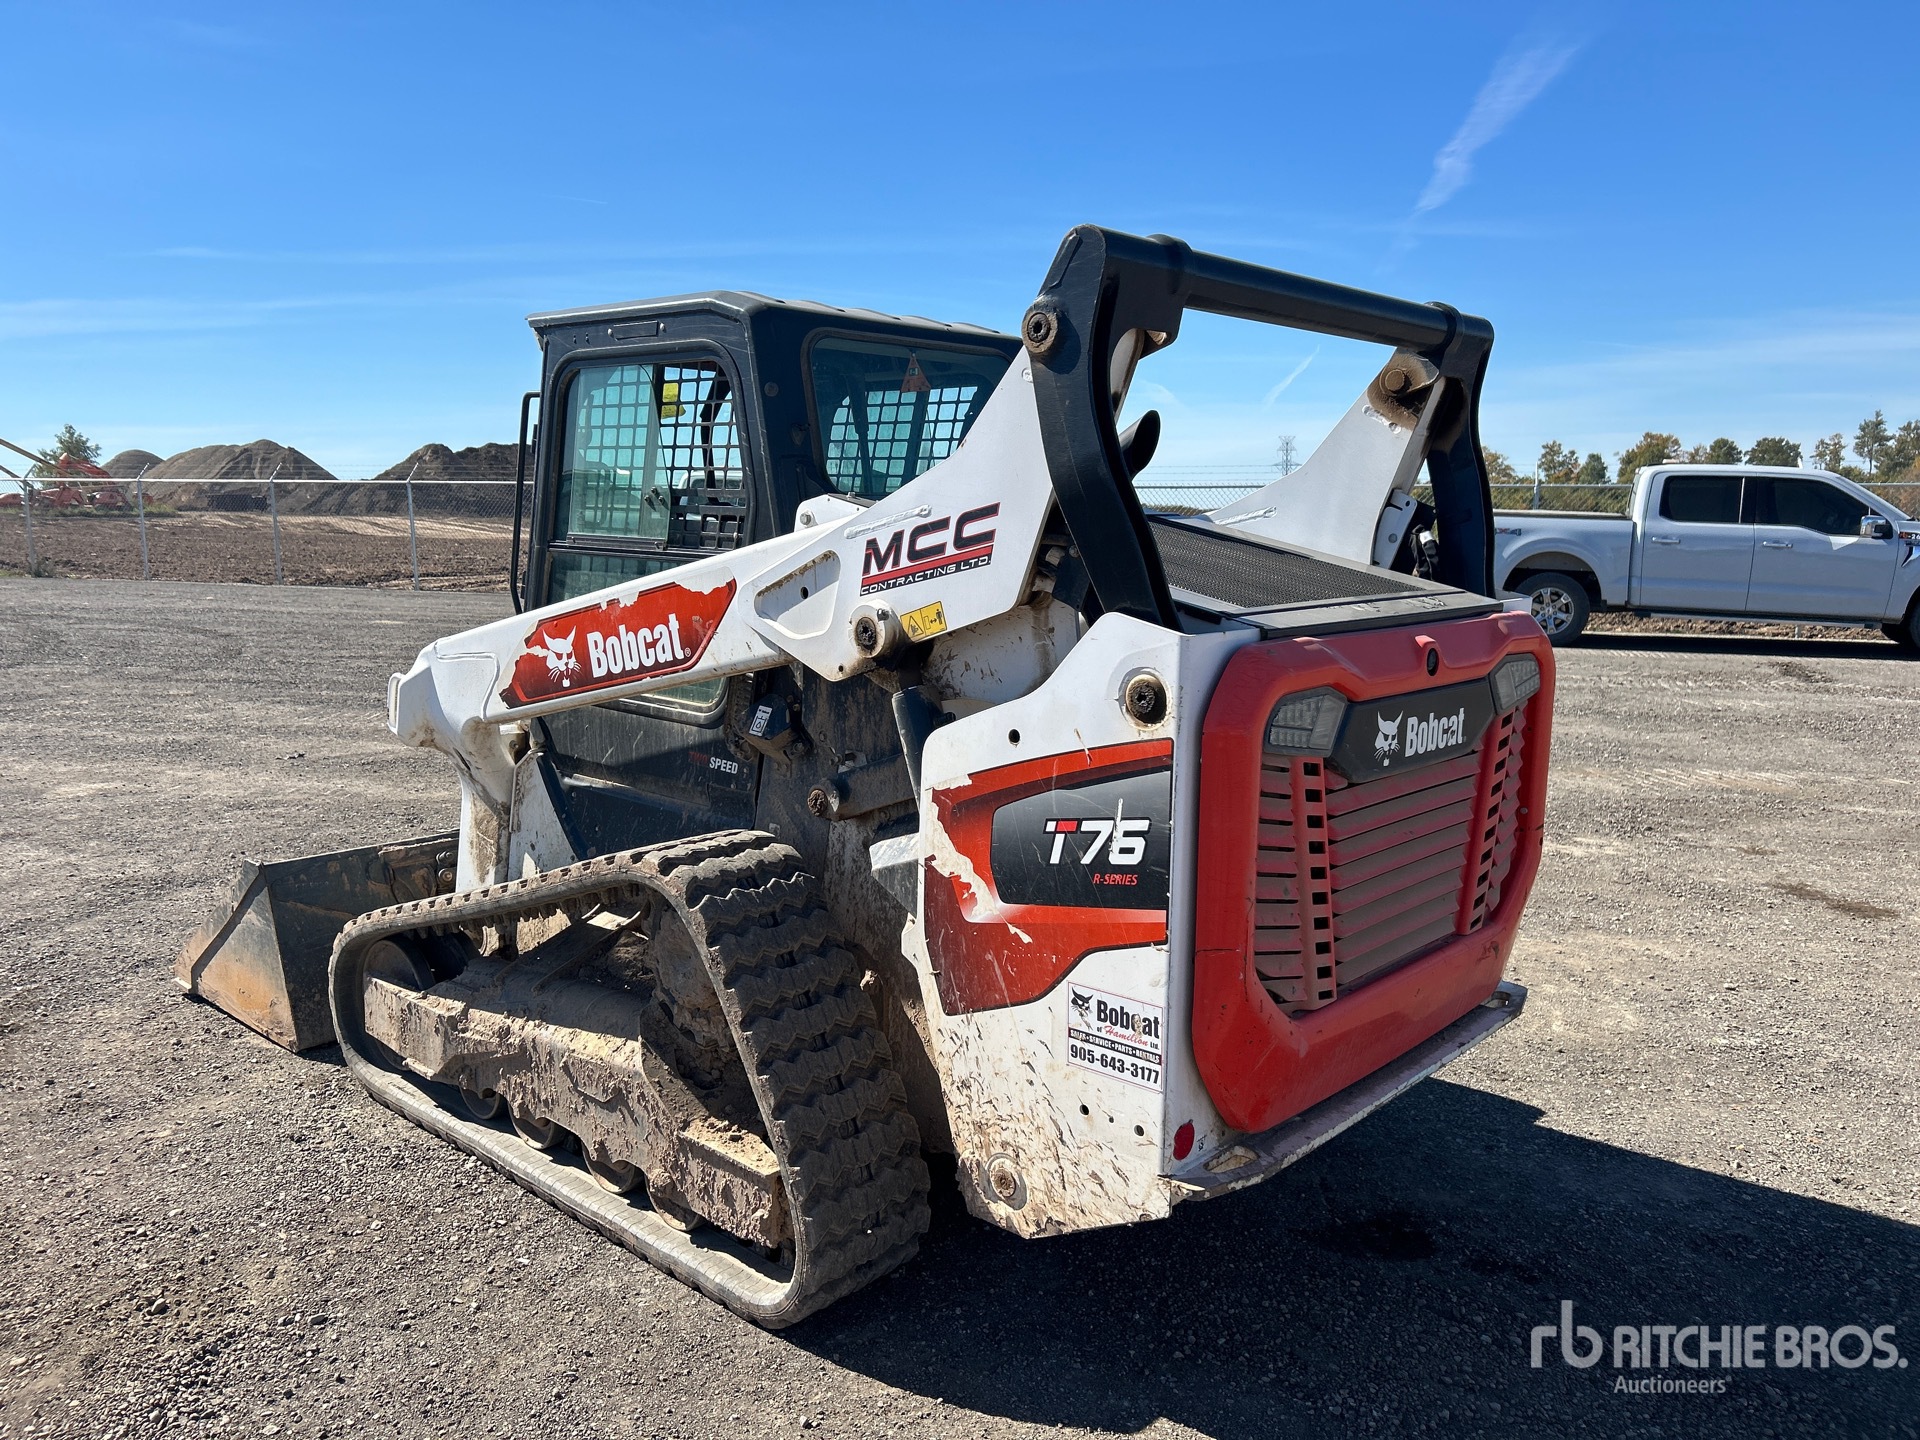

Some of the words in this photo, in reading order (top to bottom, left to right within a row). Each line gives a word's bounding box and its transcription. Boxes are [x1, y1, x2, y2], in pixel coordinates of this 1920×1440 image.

[862, 502, 1000, 576] MCC
[860, 563, 956, 596] CONTRACTING
[961, 555, 991, 570] LTD.
[586, 613, 685, 678] Bobcat
[1405, 707, 1465, 758] Bobcat
[709, 756, 739, 774] SPEED
[1045, 819, 1150, 865] T76
[1093, 873, 1138, 886] R-SERIES
[1070, 1044, 1160, 1084] 905-643-3177
